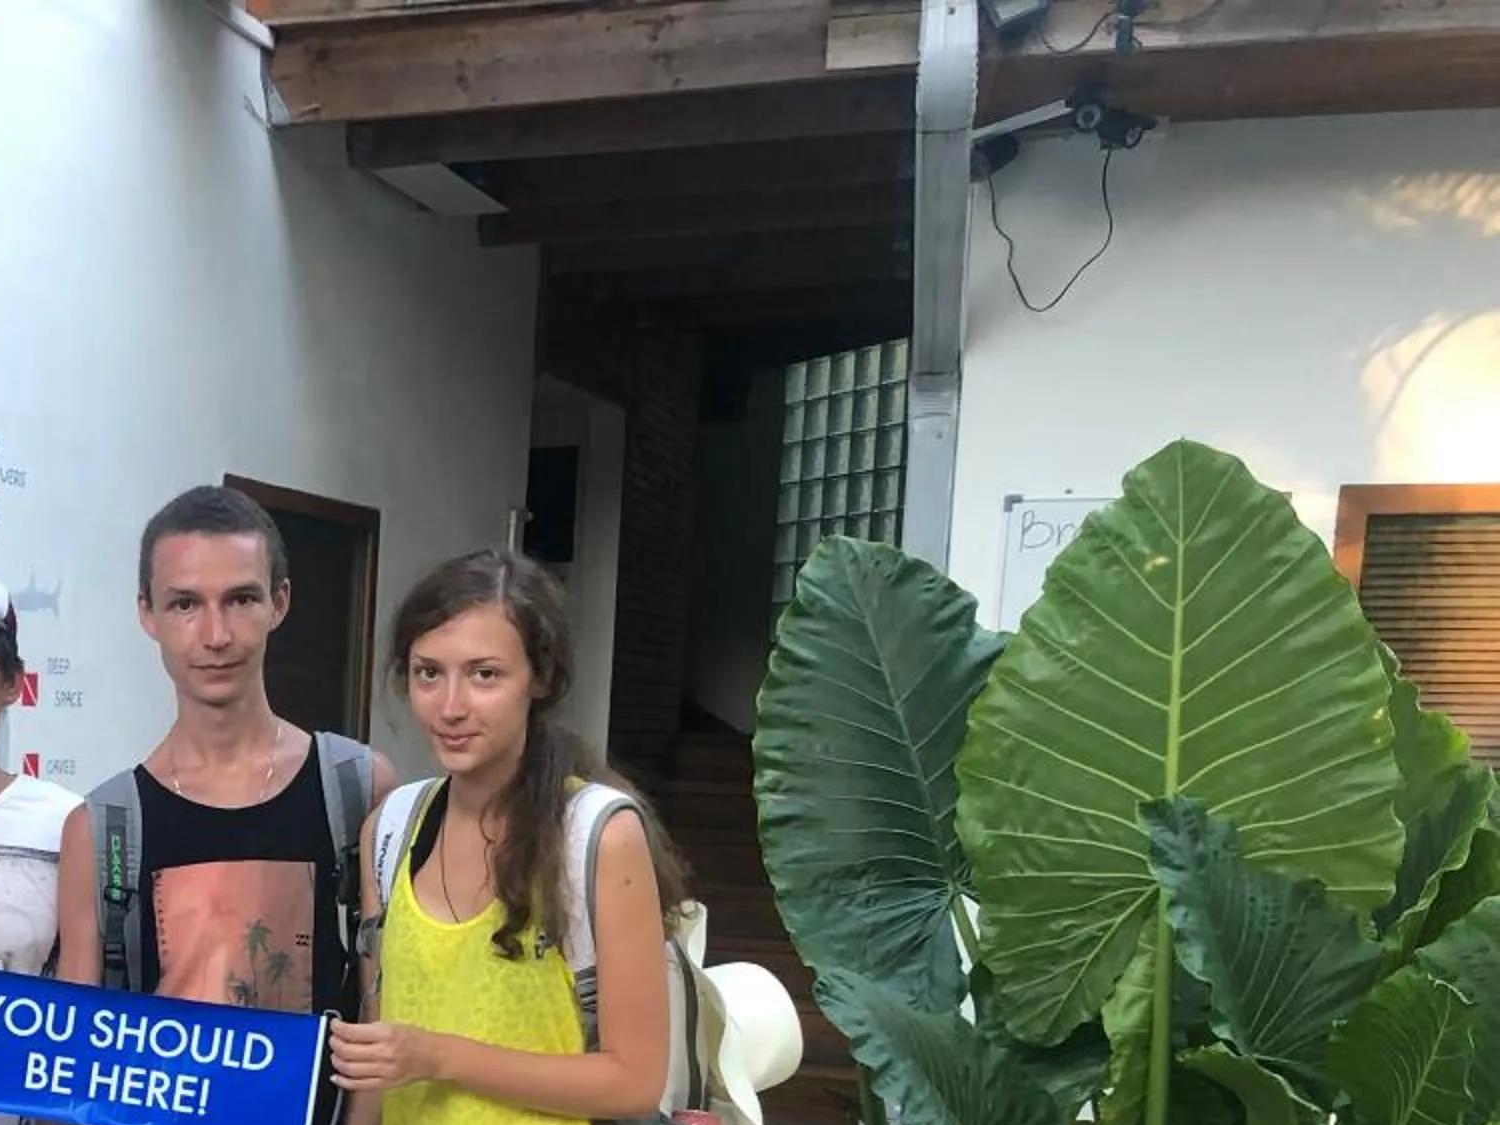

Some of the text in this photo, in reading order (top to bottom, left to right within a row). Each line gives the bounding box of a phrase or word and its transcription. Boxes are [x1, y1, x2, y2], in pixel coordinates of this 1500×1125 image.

[89, 1009, 275, 1071] SHOULD
[24, 1051, 211, 1116] BE HERE!
